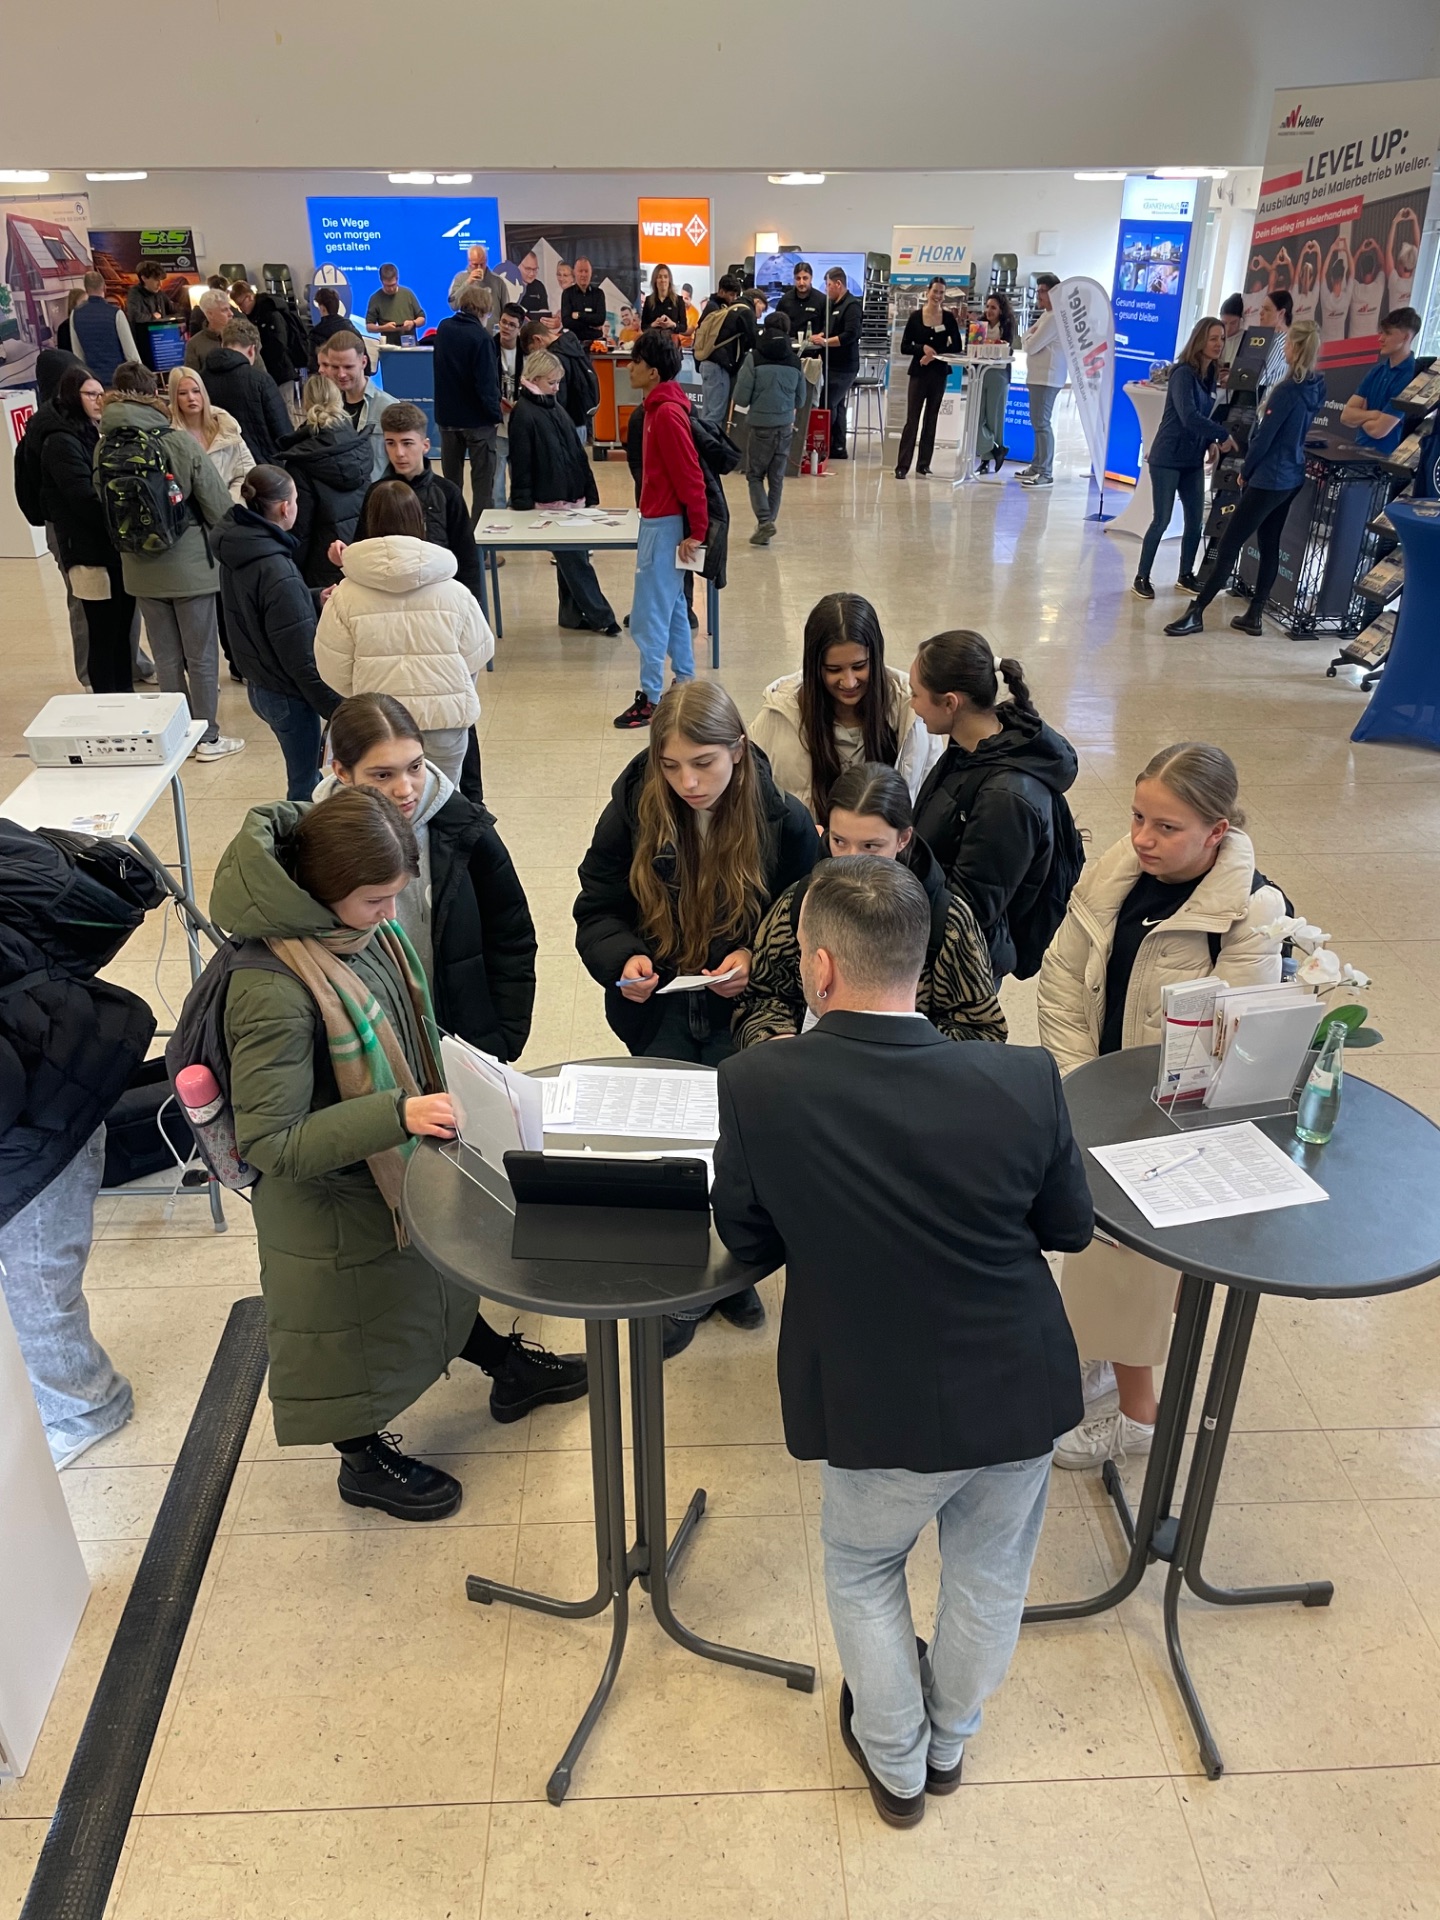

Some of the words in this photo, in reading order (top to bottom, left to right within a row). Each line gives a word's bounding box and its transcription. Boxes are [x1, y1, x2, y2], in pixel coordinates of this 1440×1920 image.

[1297, 115, 1325, 128] Weller
[1305, 140, 1364, 184] LEVEL
[1370, 128, 1410, 164] UP:
[1259, 190, 1310, 215] Ausbildung
[1311, 184, 1327, 200] bei
[1328, 165, 1392, 195] Malerbetrieb
[1394, 156, 1432, 175] Weller.
[322, 218, 339, 228] Die
[340, 217, 370, 229] Wege
[1255, 227, 1270, 240] Dein
[1270, 219, 1295, 236] Einstieg
[1296, 218, 1306, 228] ins
[1305, 204, 1360, 227] Malerhandwerk
[140, 229, 189, 245] S&S
[323, 231, 342, 239] von
[343, 231, 381, 241] morgen
[325, 242, 371, 253] gestalten
[918, 245, 967, 263] HORN
[1115, 297, 1136, 308] Gesund
[1136, 301, 1156, 310] werden
[1118, 311, 1138, 322] gesund
[1138, 312, 1159, 322] bleiben
